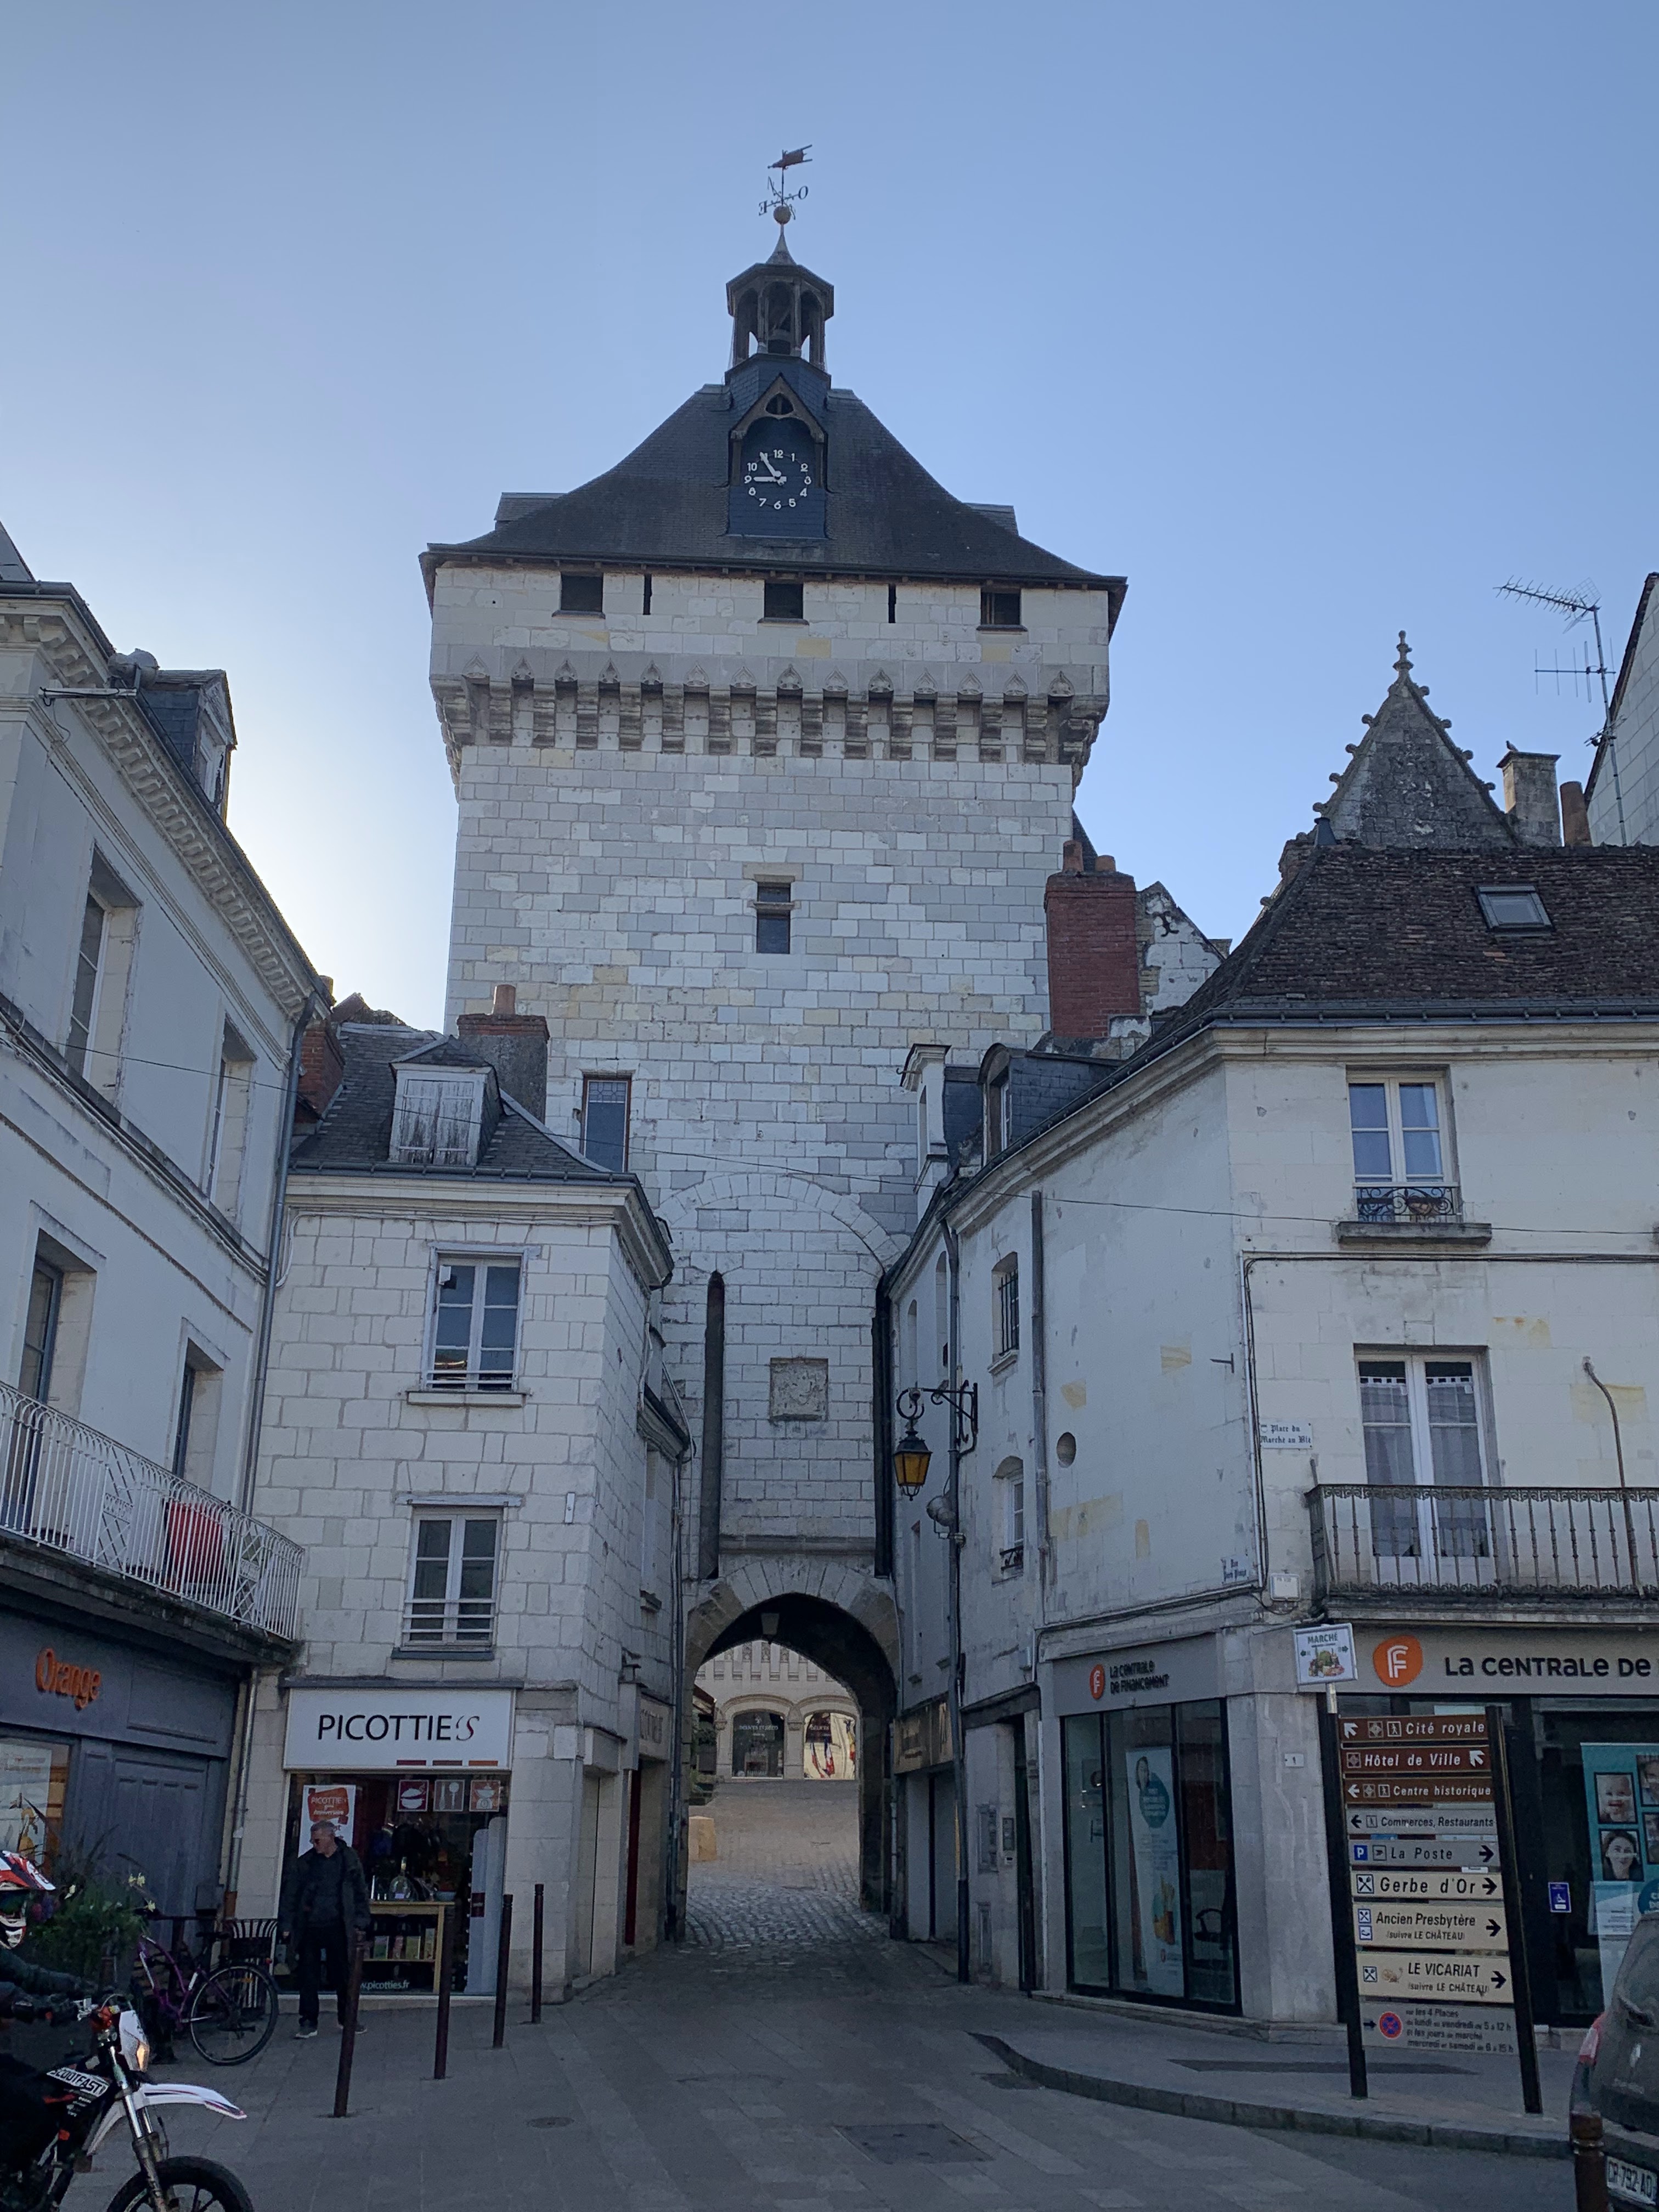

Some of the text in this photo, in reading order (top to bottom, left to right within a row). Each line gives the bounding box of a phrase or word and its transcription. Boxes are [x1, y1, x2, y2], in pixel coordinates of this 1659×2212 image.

[773, 449, 783, 459] 12
[791, 453, 795, 461] 1
[747, 462, 757, 471] 10
[800, 463, 808, 472] 2
[744, 475, 752, 484] 9
[804, 476, 811, 484] 3
[748, 487, 756, 496] 8
[799, 488, 807, 497] 4
[759, 498, 766, 507] 7
[774, 500, 781, 510] 6
[788, 498, 796, 507] 5
[1307, 1632, 1339, 1644] MARCHÉ
[36, 1647, 101, 1711] Orange
[1406, 1720, 1485, 1736] Cité royale
[1364, 1753, 1460, 1767] Hôtel de Ville
[1393, 1785, 1491, 1798] Centre historique
[1381, 1816, 1494, 1828] Commerces, Restaurants
[1357, 1846, 1453, 1860] P La Poste
[1380, 1877, 1476, 1893] Gerbe d'Or
[1376, 1912, 1475, 1928] Ancien Presbytère
[1408, 1962, 1480, 1977] LE VICARIAT
[1437, 1983, 1445, 1991] LE
[1484, 2022, 1489, 2030] 5
[1497, 2022, 1504, 2030] 12
